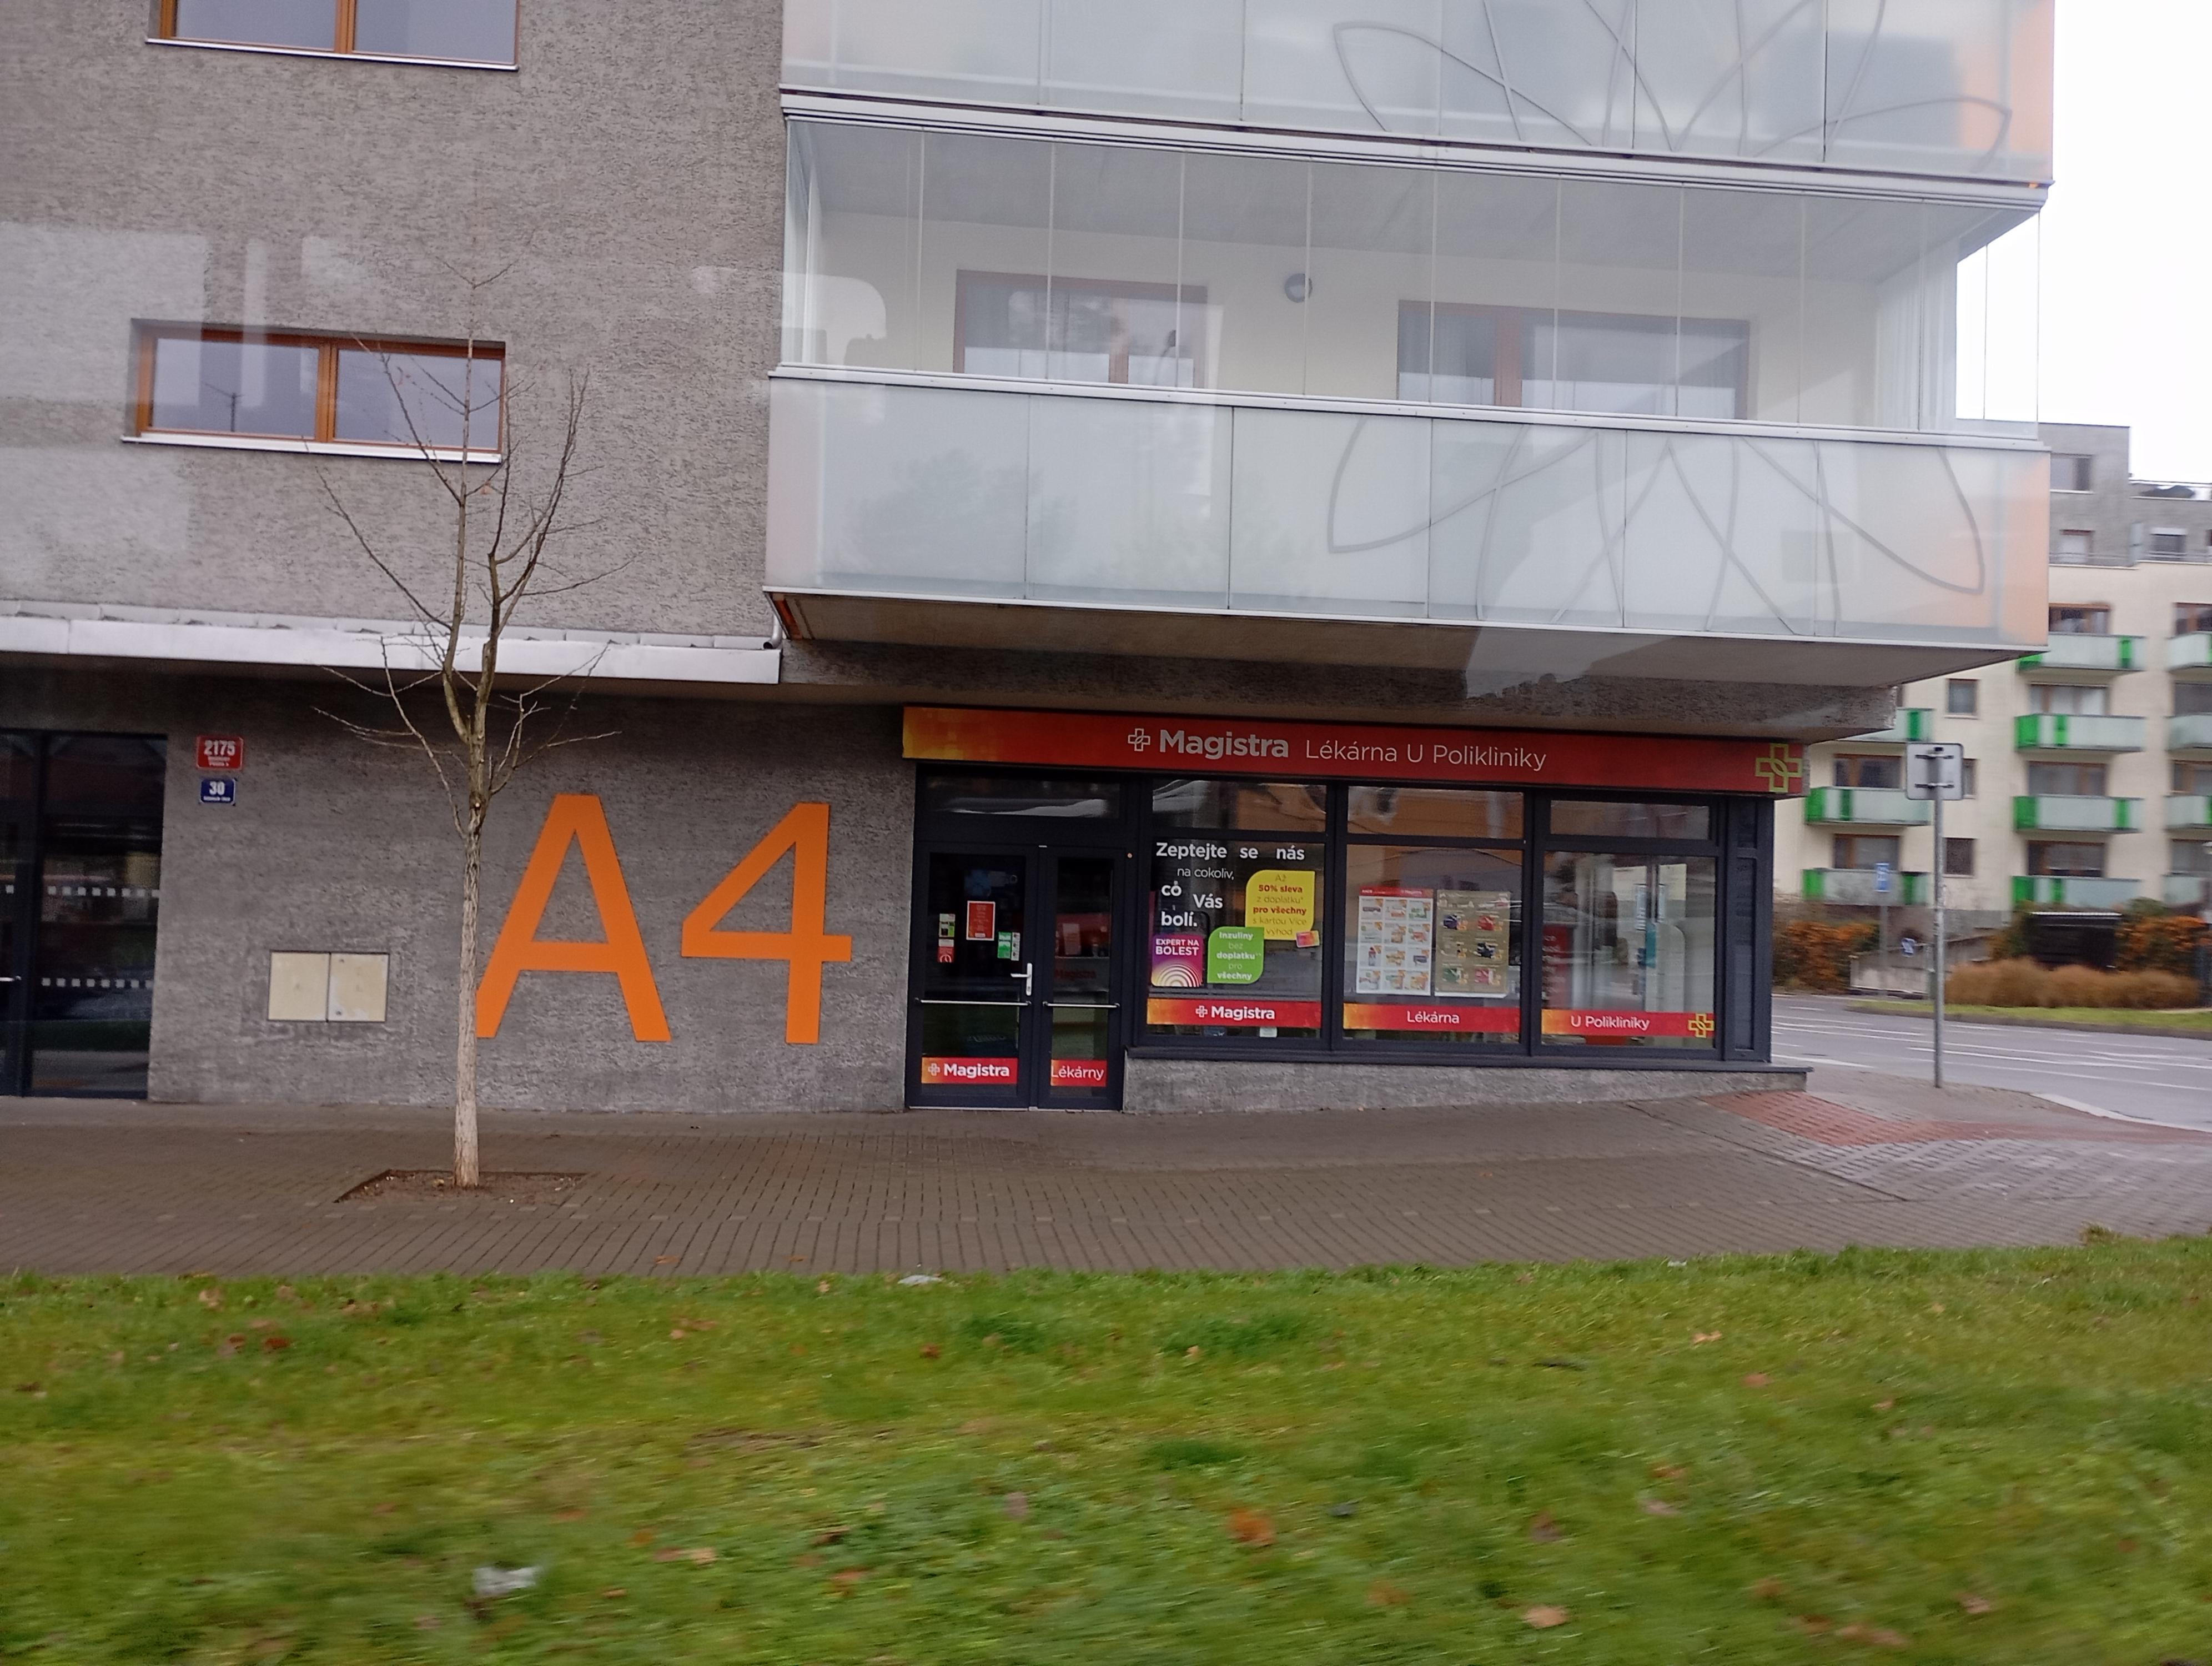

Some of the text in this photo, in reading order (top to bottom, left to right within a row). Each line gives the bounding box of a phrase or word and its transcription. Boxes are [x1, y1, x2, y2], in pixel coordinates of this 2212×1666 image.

[203, 739, 235, 756] 2175
[1159, 729, 1546, 771] Magistra Lékárna U Polikliniky
[209, 781, 225, 795] 30
[1156, 842, 1305, 860] Zeptejte se nás
[1177, 867, 1234, 880] na cokoliv,
[1161, 885, 1182, 896] co
[1193, 893, 1223, 909] Vás
[1270, 906, 1306, 916] všechny
[476, 793, 852, 1044] A4
[1161, 911, 1198, 927] bolí.
[1155, 938, 1187, 946] EXPERT
[1219, 931, 1253, 941] Inzuliny
[1155, 946, 1199, 956] BOLEST
[1217, 971, 1253, 980] všechny
[1210, 1005, 1275, 1021] Magistra
[1406, 1011, 1460, 1024] Lékárna
[1571, 1015, 1650, 1030] U Polikliniky
[943, 1063, 1104, 1081] Magistra Lékárny
